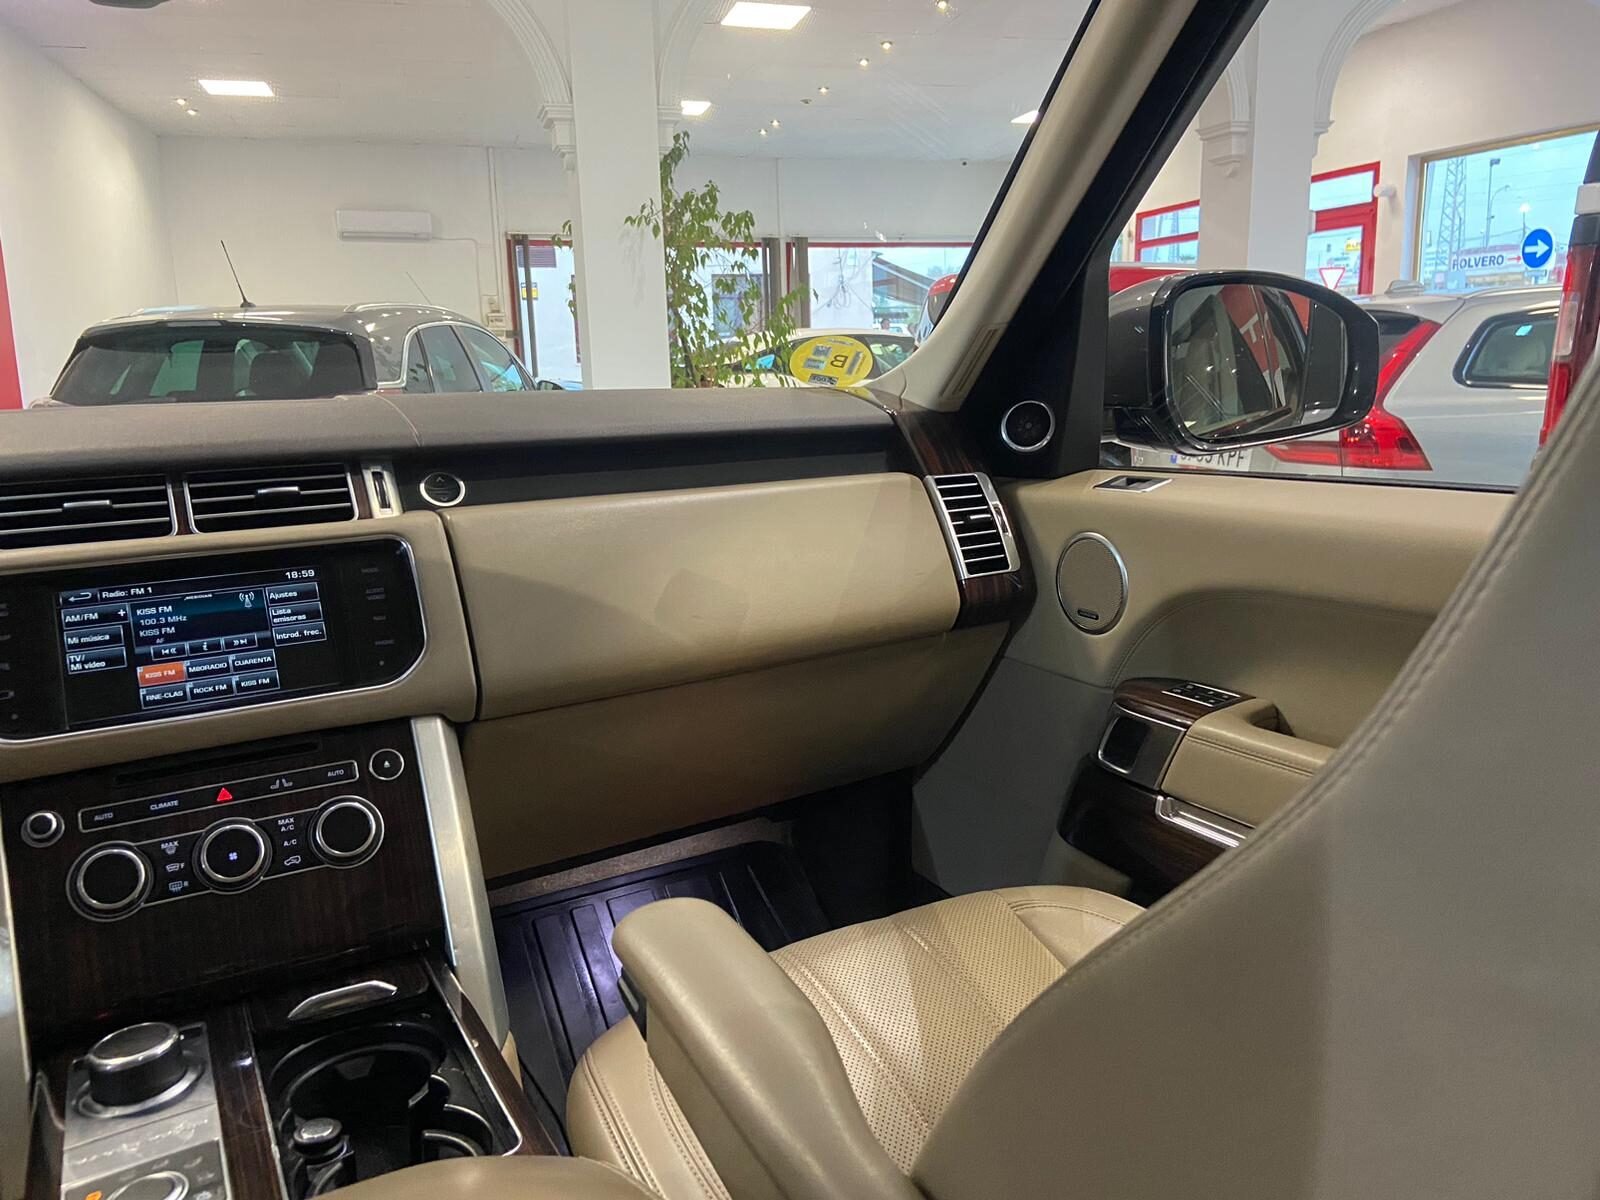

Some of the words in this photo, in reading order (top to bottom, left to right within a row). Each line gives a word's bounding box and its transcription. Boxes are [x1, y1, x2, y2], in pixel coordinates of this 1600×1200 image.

[285, 568, 315, 580] 18:59
[102, 589, 129, 599] Radio:
[131, 587, 145, 596] FM
[148, 586, 153, 594] 1
[269, 590, 298, 601] Ajustes
[136, 606, 157, 616] KISS
[158, 605, 173, 613] FM
[272, 608, 291, 616] Lista
[65, 612, 99, 622] AM/FM
[140, 617, 166, 626] 100.3
[167, 615, 188, 623] MHz
[273, 613, 307, 623] emisoras
[139, 628, 160, 637] KISS
[161, 626, 176, 635] FM
[276, 631, 302, 641] Introd.
[304, 628, 322, 637] frec.
[67, 635, 79, 644] Mi
[80, 632, 110, 643] música
[69, 654, 86, 663] TV/
[234, 656, 272, 667] CUARENTA
[70, 662, 82, 671] Mi
[145, 671, 162, 679] KISS
[164, 669, 176, 677] FM
[240, 679, 257, 688] KISS
[258, 677, 270, 685] FM
[193, 685, 214, 695] ROCK
[215, 683, 227, 692] FM
[146, 690, 184, 702] RNE-CLAS
[327, 768, 345, 778] AUTO
[149, 799, 179, 811] CLIMATE
[93, 811, 114, 821] AUTO
[278, 817, 295, 826] MAX
[280, 823, 295, 832] A/C
[160, 840, 179, 850] MAX
[283, 838, 298, 846] A/C
